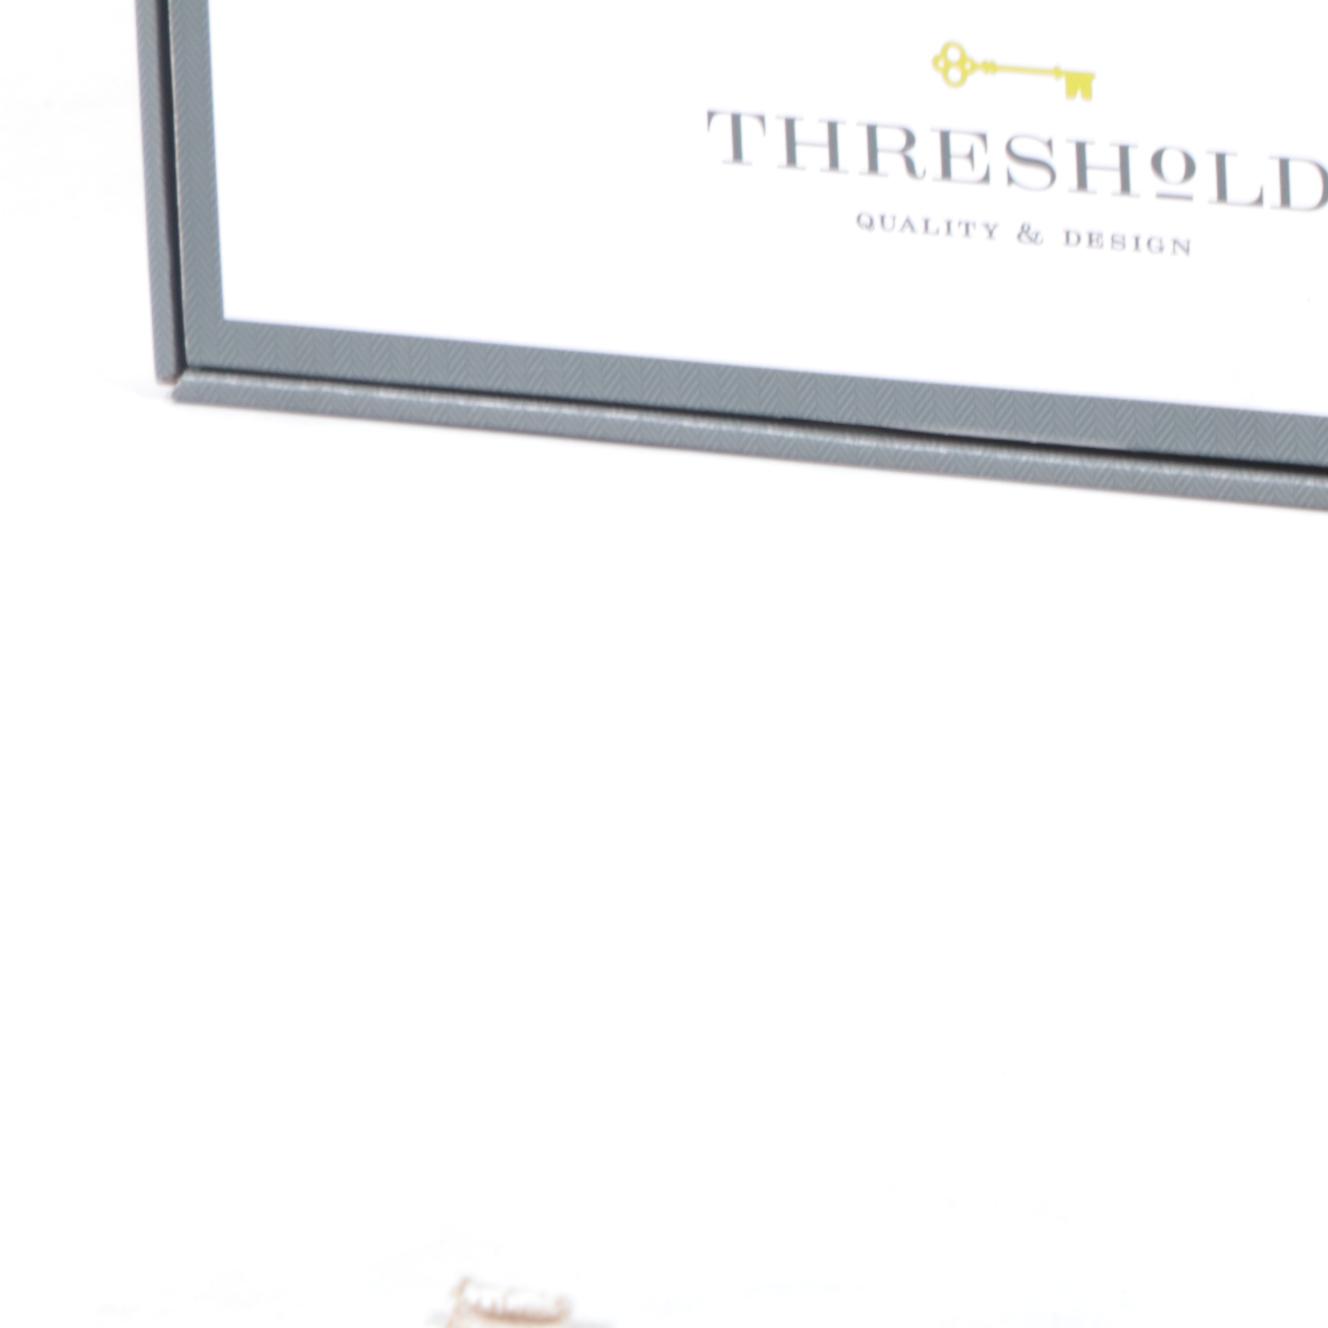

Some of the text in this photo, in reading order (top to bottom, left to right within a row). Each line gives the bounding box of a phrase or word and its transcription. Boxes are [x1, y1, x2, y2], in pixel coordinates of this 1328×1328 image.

[856, 212, 1191, 256] QUALITY & DESIGN
